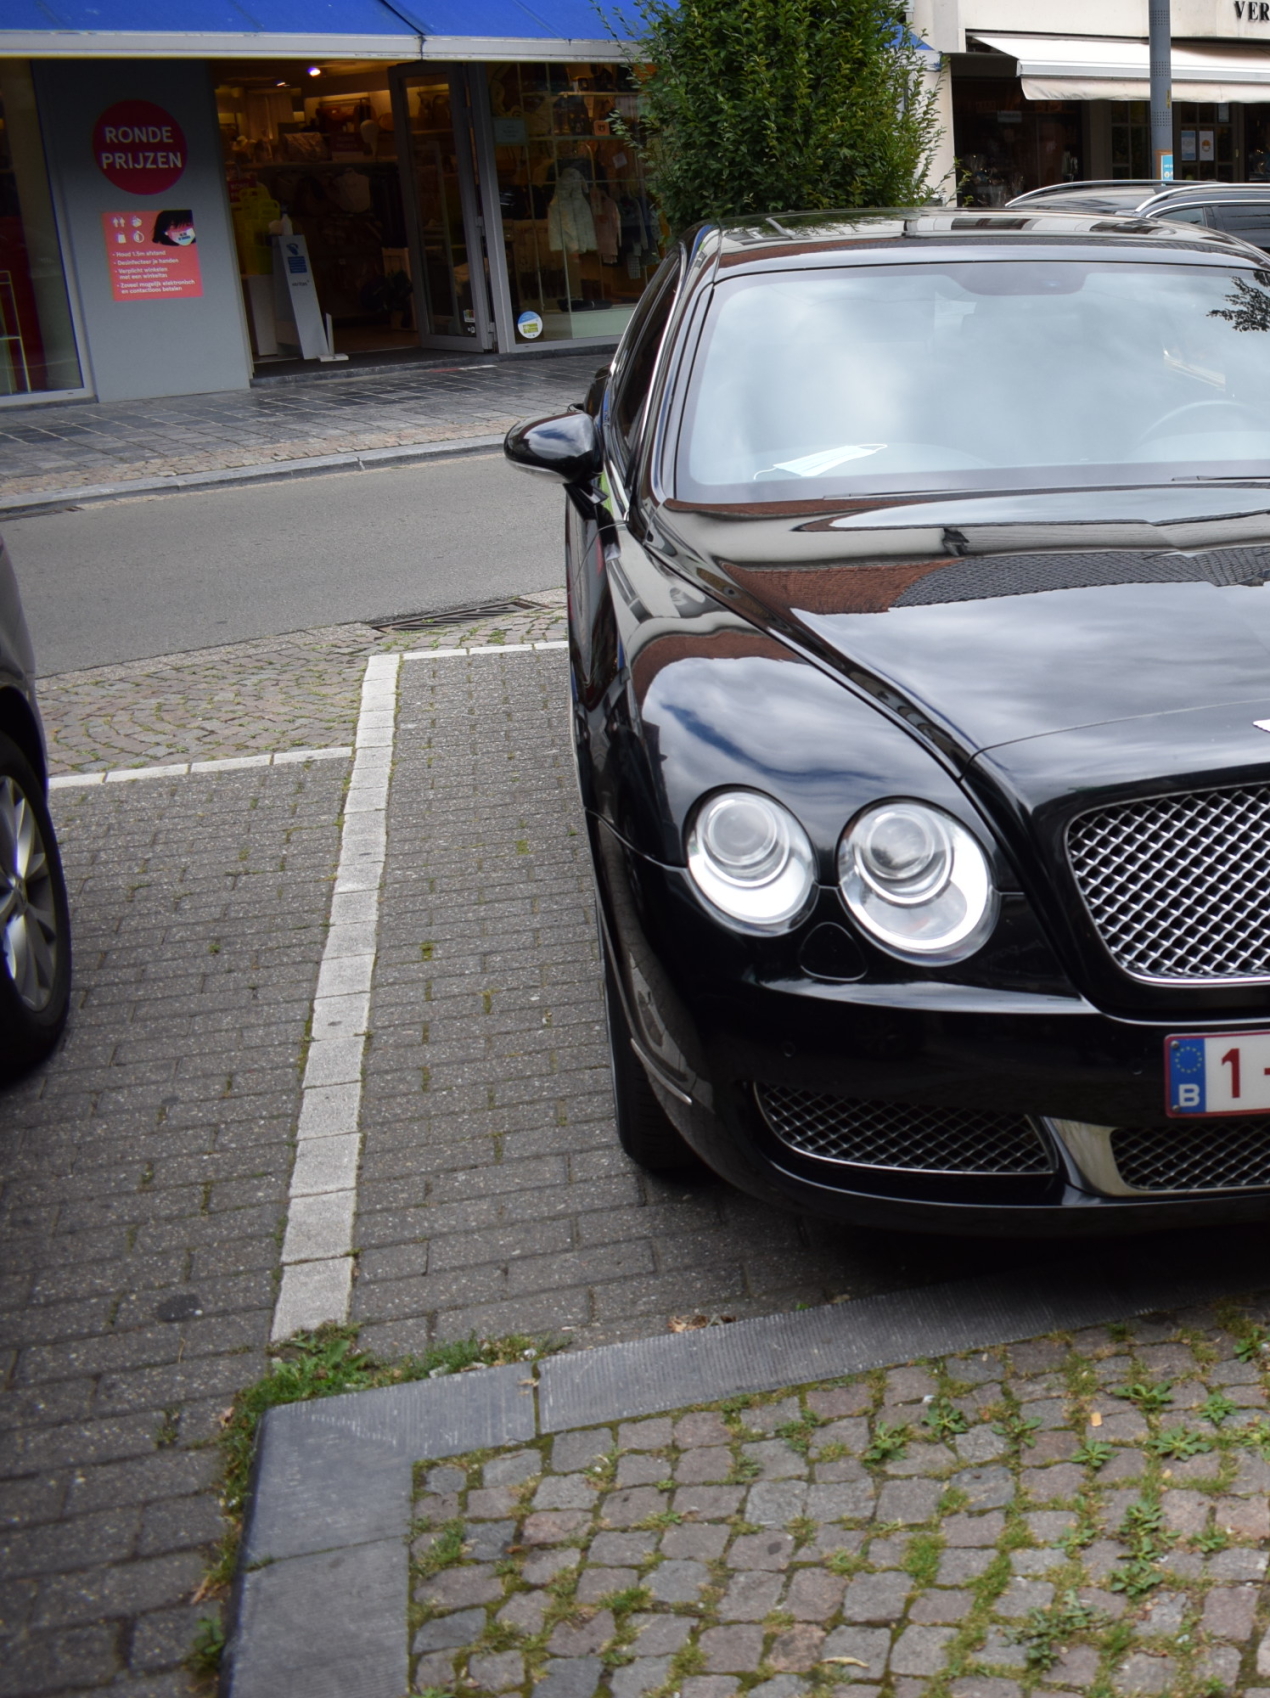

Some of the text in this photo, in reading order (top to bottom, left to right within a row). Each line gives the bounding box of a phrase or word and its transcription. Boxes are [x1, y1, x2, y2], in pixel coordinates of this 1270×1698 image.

[105, 126, 174, 143] RONDE
[101, 152, 183, 169] PRIJZEN
[1178, 1084, 1200, 1107] B
